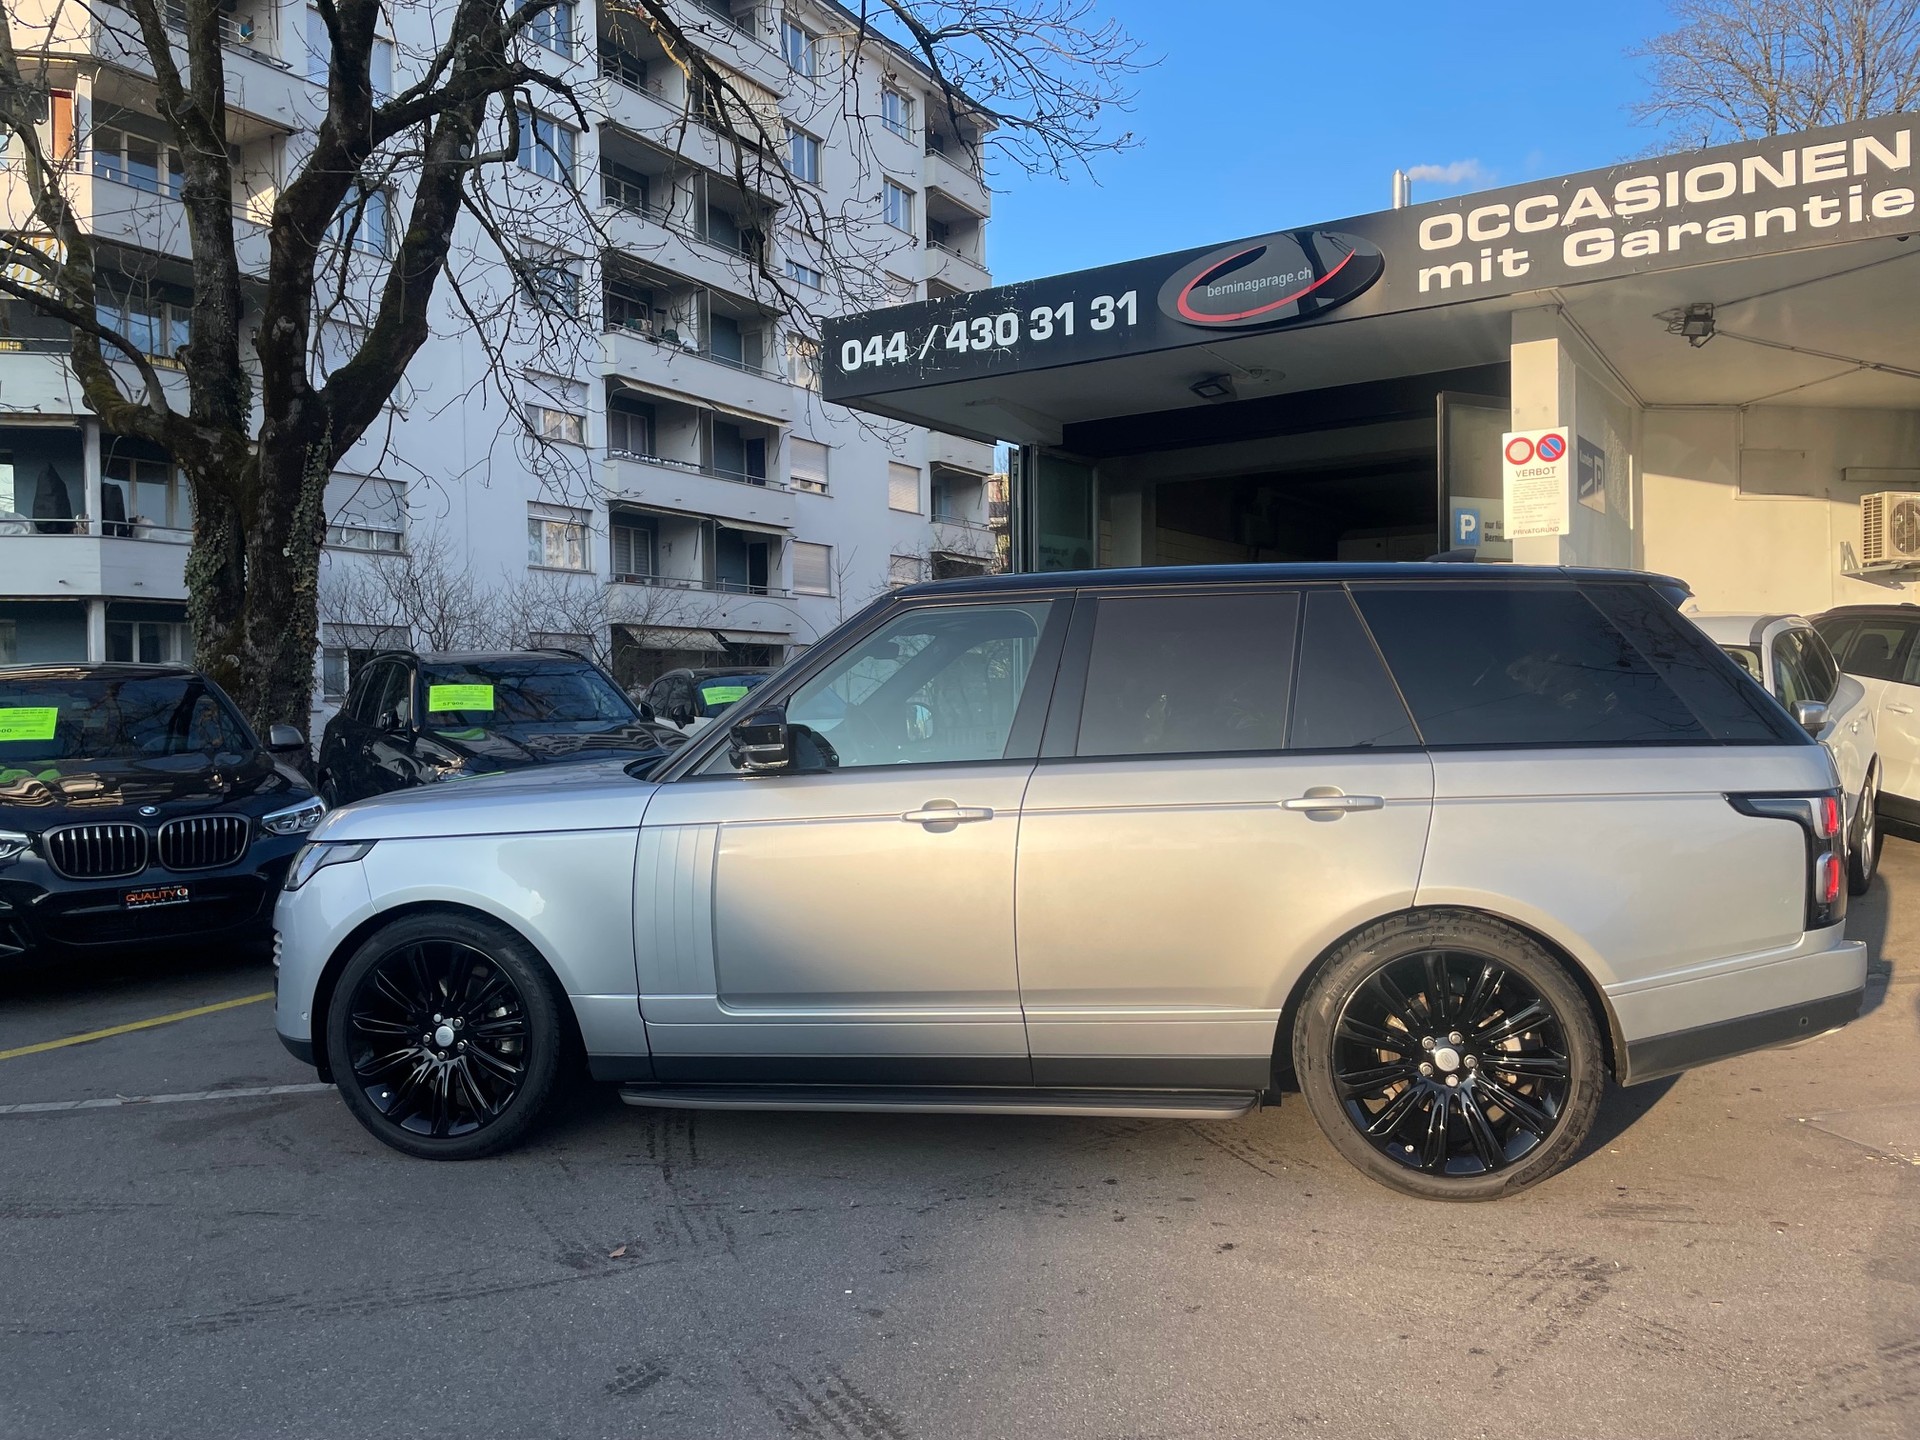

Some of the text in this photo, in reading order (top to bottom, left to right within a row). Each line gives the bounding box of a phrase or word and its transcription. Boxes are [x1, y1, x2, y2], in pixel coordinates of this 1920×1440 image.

[1418, 129, 1911, 251] OCCASIONEN
[1418, 184, 1916, 293] mit Garantie
[1207, 266, 1312, 297] berninagarage.ch
[841, 331, 906, 371] 044
[945, 312, 1019, 353] 430
[1029, 301, 1074, 341] 31
[1089, 290, 1137, 332] 31
[1516, 466, 1557, 477] VERBOT
[1460, 514, 1476, 540] P
[1513, 526, 1560, 536] PRIVATGRUND
[126, 889, 177, 902] QUALITY
